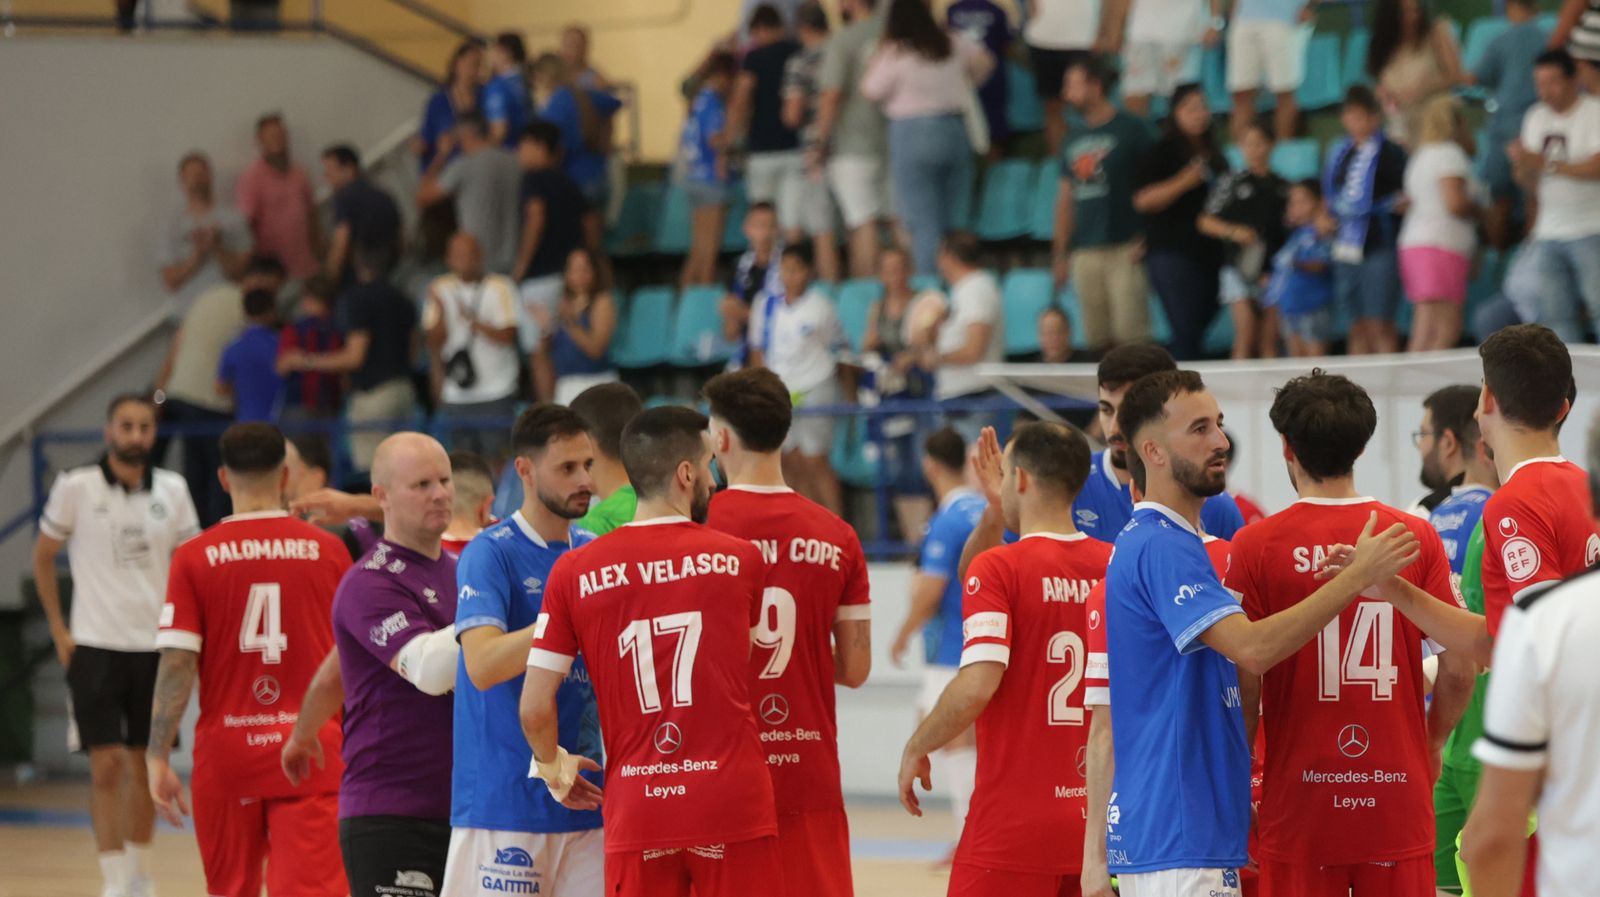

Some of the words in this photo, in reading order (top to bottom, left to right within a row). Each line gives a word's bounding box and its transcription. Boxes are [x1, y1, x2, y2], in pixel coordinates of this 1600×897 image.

[204, 538, 320, 568] PALOMARES
[789, 537, 842, 572] COPE
[578, 563, 630, 599] ALEX
[637, 552, 740, 585] VELASCO
[239, 582, 288, 665] 4
[618, 611, 703, 715] 17
[1317, 601, 1399, 702] 14
[759, 728, 822, 742] edes-Benz
[620, 759, 718, 778] Mercedes-Benz
[765, 752, 800, 765] eyva
[1302, 769, 1408, 783] Mercedes-Benz
[645, 784, 686, 799] Leyva
[1333, 794, 1376, 811] Leyva
